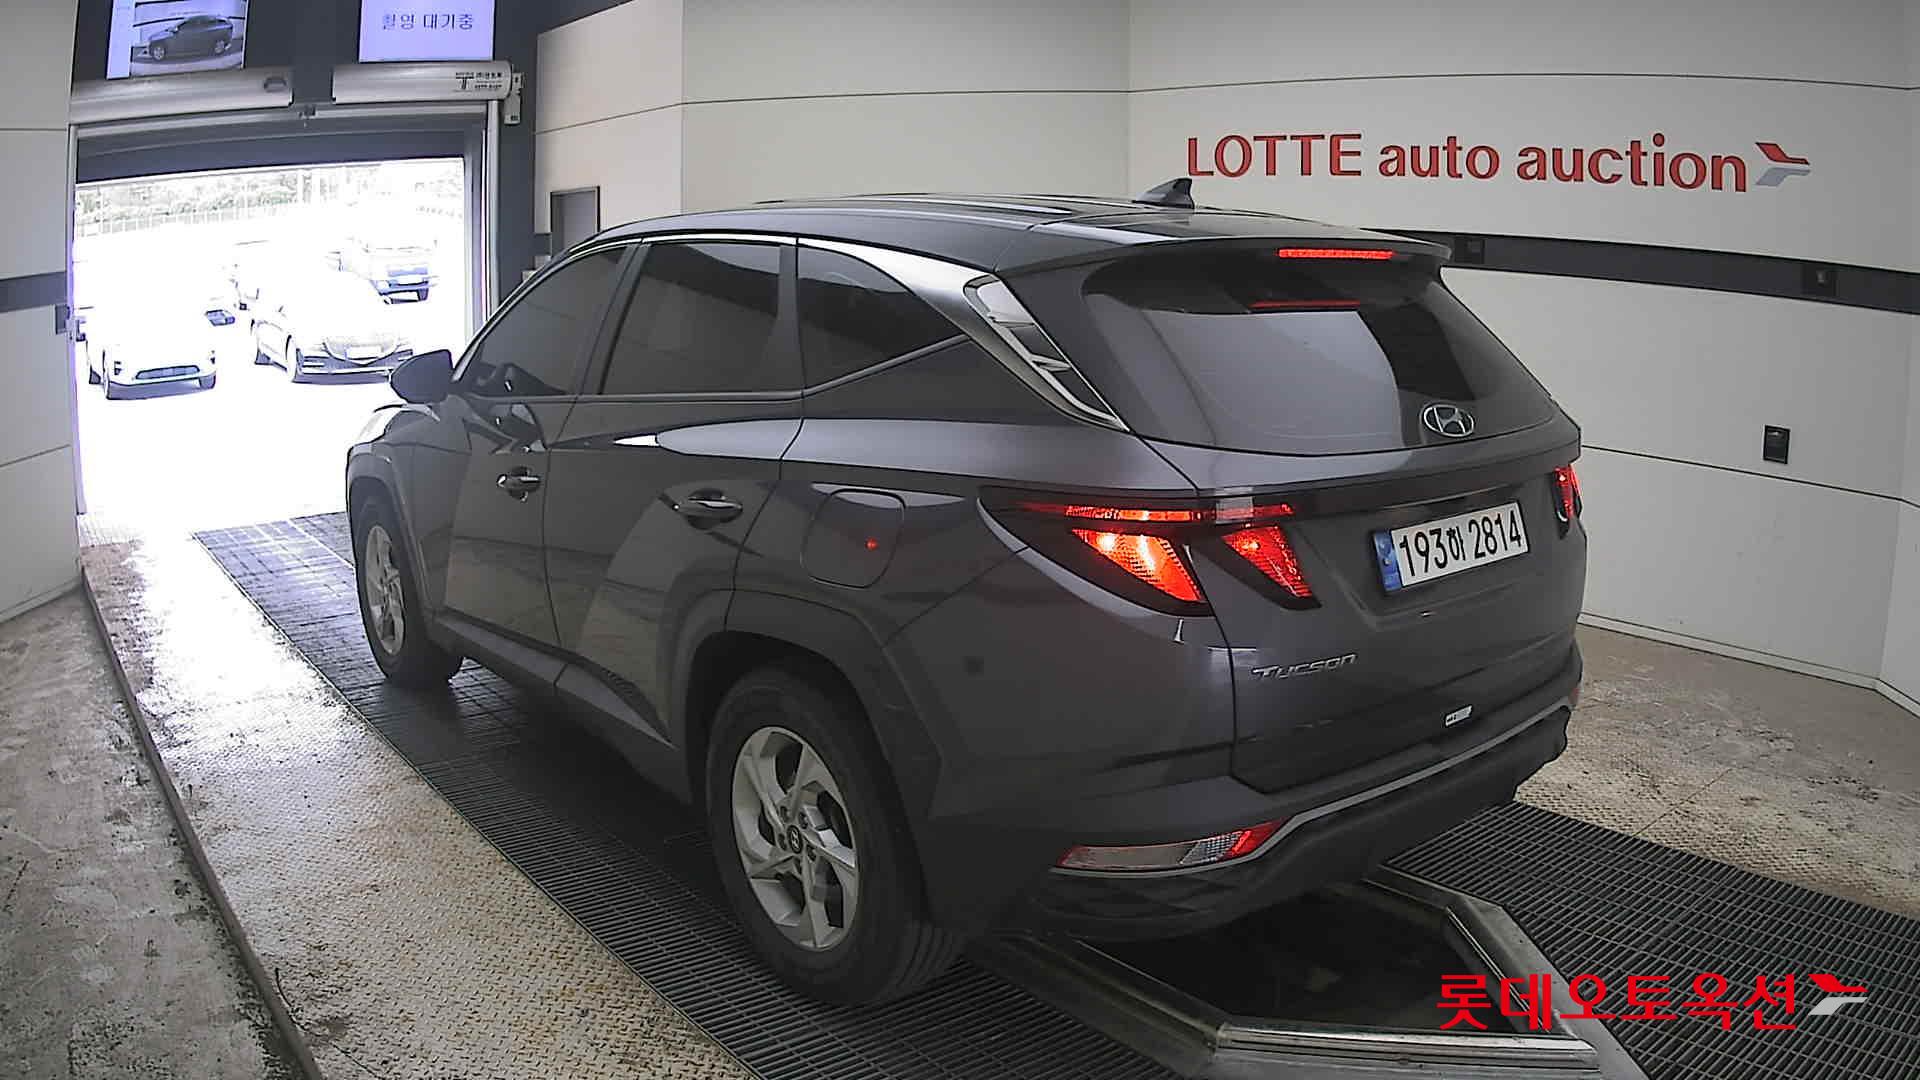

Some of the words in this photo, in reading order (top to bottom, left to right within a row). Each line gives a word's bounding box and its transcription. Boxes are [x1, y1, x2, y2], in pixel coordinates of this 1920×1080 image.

[1187, 133, 1363, 178] LOTTE
[1379, 136, 1500, 180] auto
[1518, 133, 1748, 193] auction
[1399, 526, 1466, 577] 193하
[1468, 510, 1522, 559] 2814
